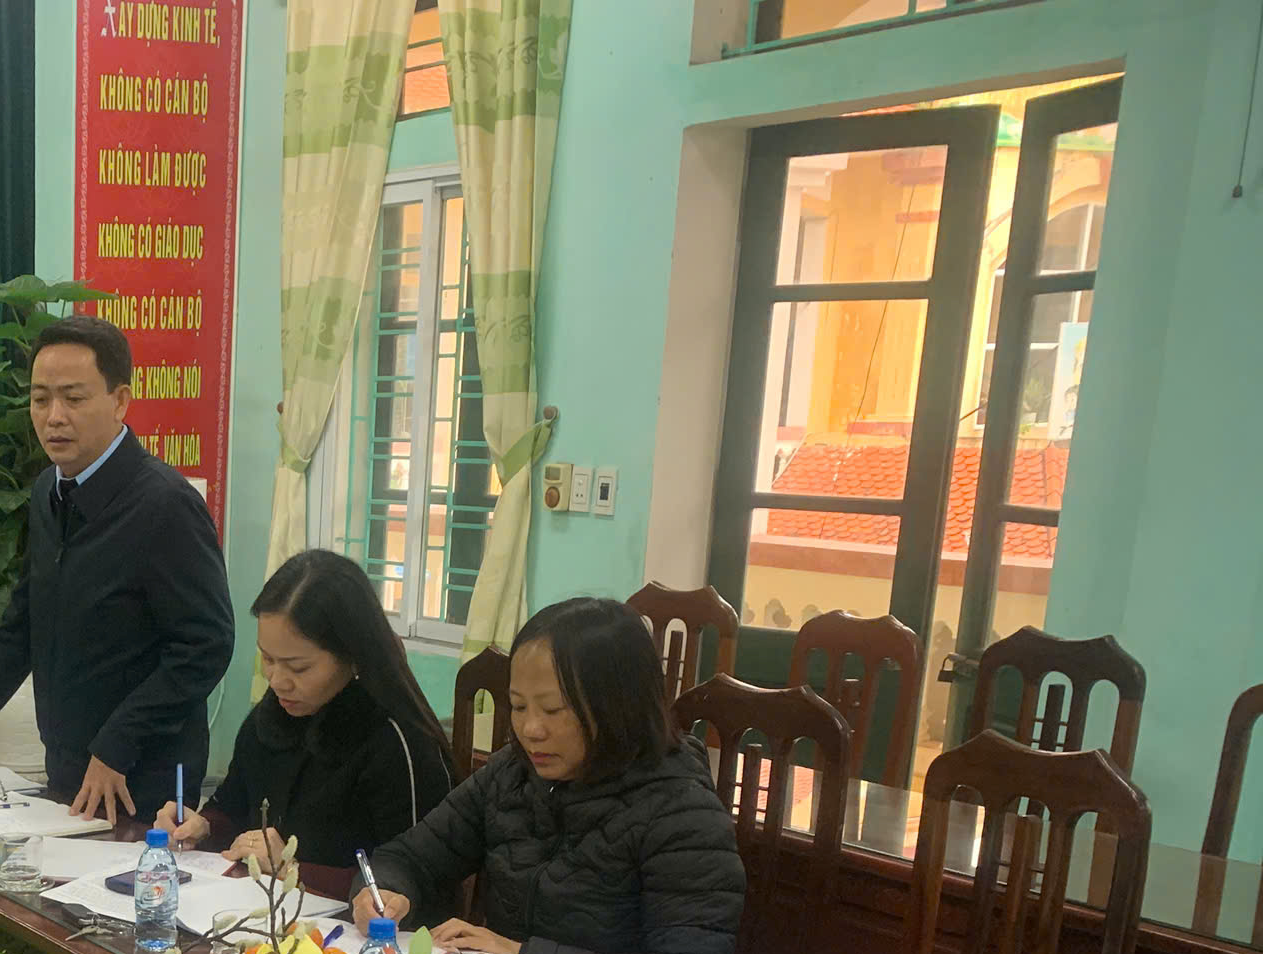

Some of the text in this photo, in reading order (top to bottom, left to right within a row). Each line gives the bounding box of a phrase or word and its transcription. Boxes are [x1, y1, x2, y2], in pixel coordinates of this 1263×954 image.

[172, 5, 201, 43] KINH
[100, 67, 208, 124] KHÔNG CÓ CÁN BỘ
[99, 142, 207, 196] KHÔNG LÀM ĐƯỢC
[98, 215, 204, 267] KHÔNG CÓ GIÁO DỤC
[97, 288, 202, 336] KHÔNG CÓ CÁN BỘ
[146, 358, 181, 399] KHÔNG
[183, 358, 201, 399] NÓI
[164, 427, 182, 467] VĂN
[183, 427, 201, 466] HÓA
